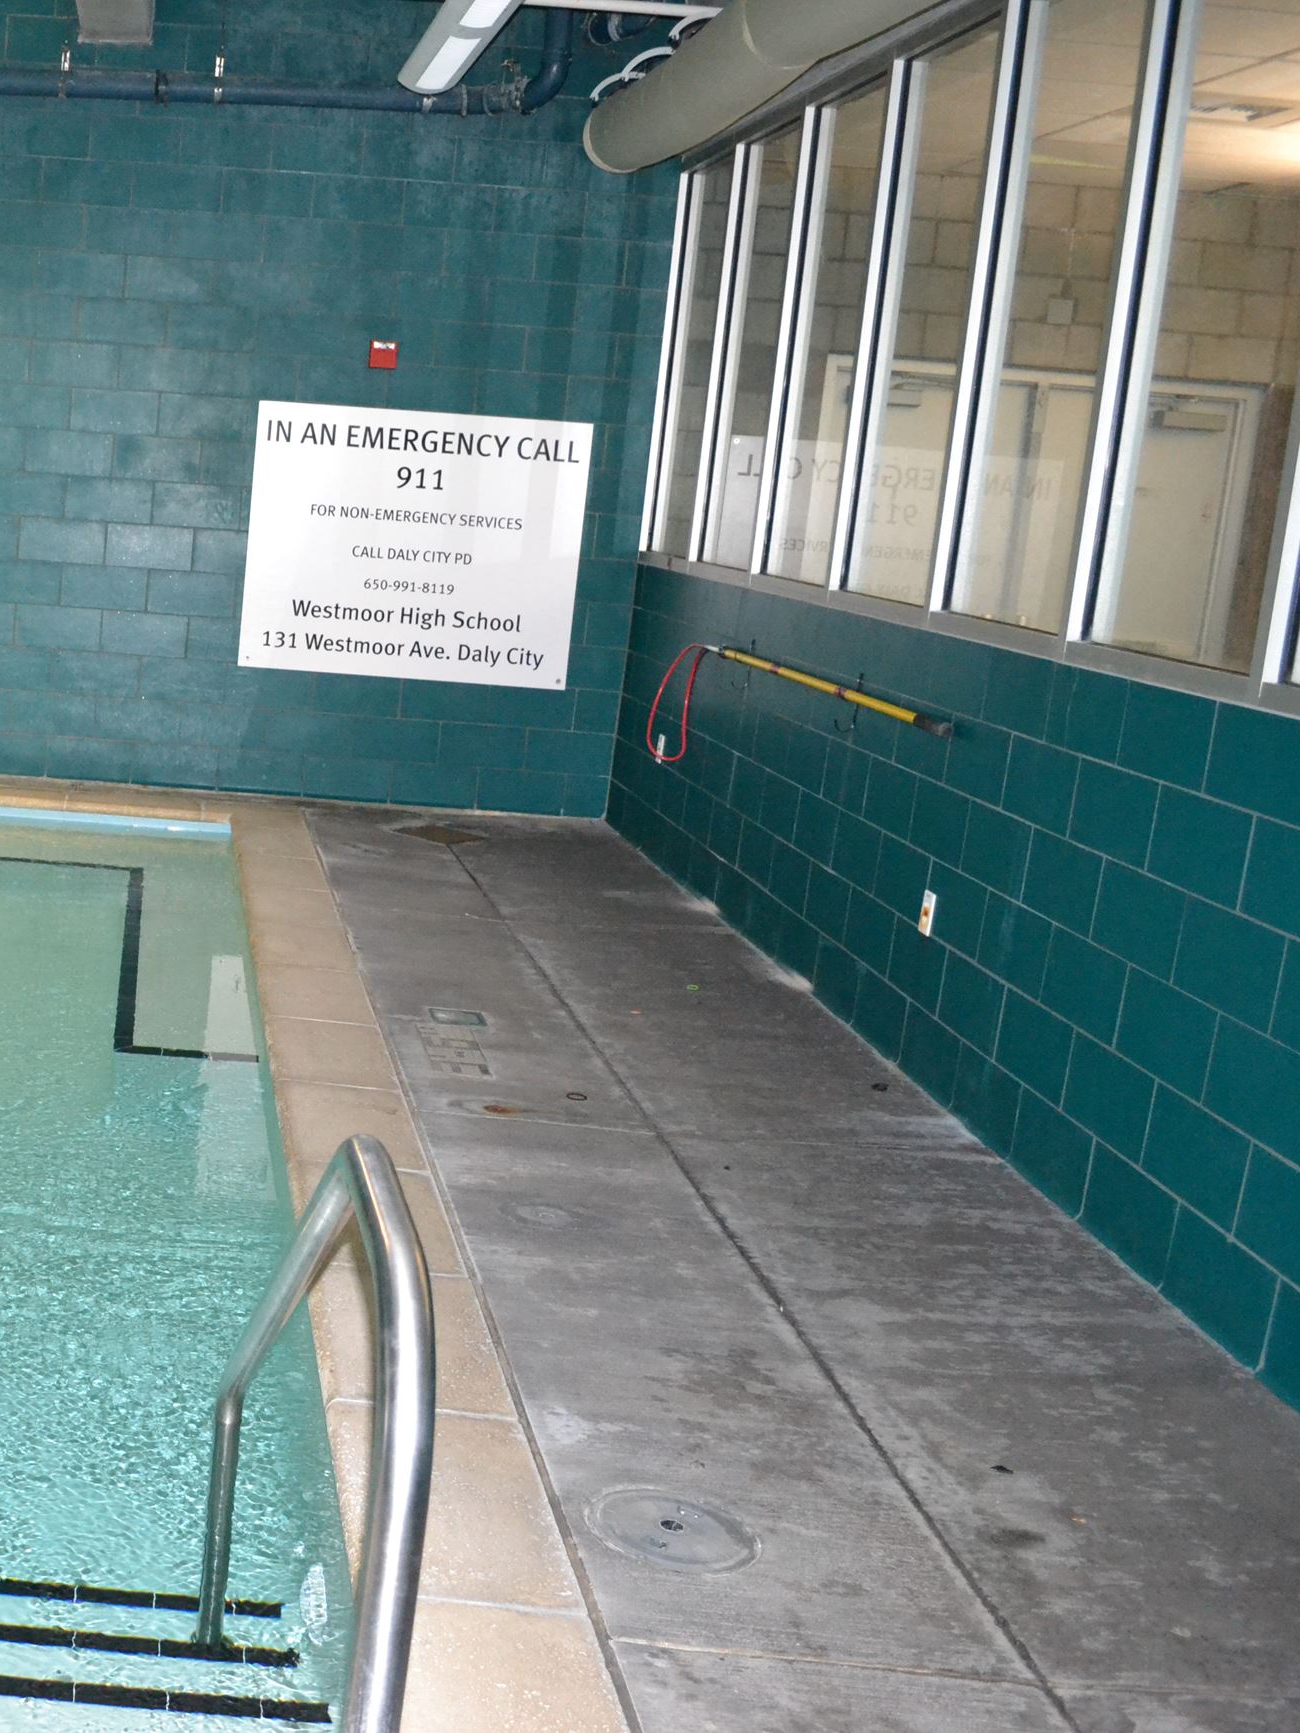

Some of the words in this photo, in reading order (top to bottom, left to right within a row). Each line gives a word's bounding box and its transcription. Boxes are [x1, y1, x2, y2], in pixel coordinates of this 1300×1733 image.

[267, 419, 292, 443] IN
[300, 422, 337, 446] AN
[346, 425, 511, 458] EMERGENCY
[517, 436, 580, 464] CALL
[397, 466, 444, 491] 911
[310, 504, 336, 517] FOR
[340, 506, 457, 525] NON-EMERGENCY
[459, 514, 523, 530] SERVICES
[352, 545, 384, 559] CALL
[387, 548, 420, 561] DALY
[422, 550, 452, 564] CITY
[454, 552, 472, 565] PD
[363, 578, 455, 595] 650-991-8119
[292, 599, 395, 623] Westmoor
[400, 606, 446, 631] High
[452, 610, 521, 633] School
[263, 630, 297, 649] 131
[305, 632, 405, 657] Westmoor
[408, 640, 450, 660] Ave.
[457, 643, 501, 668] Daly
[506, 647, 545, 671] City
